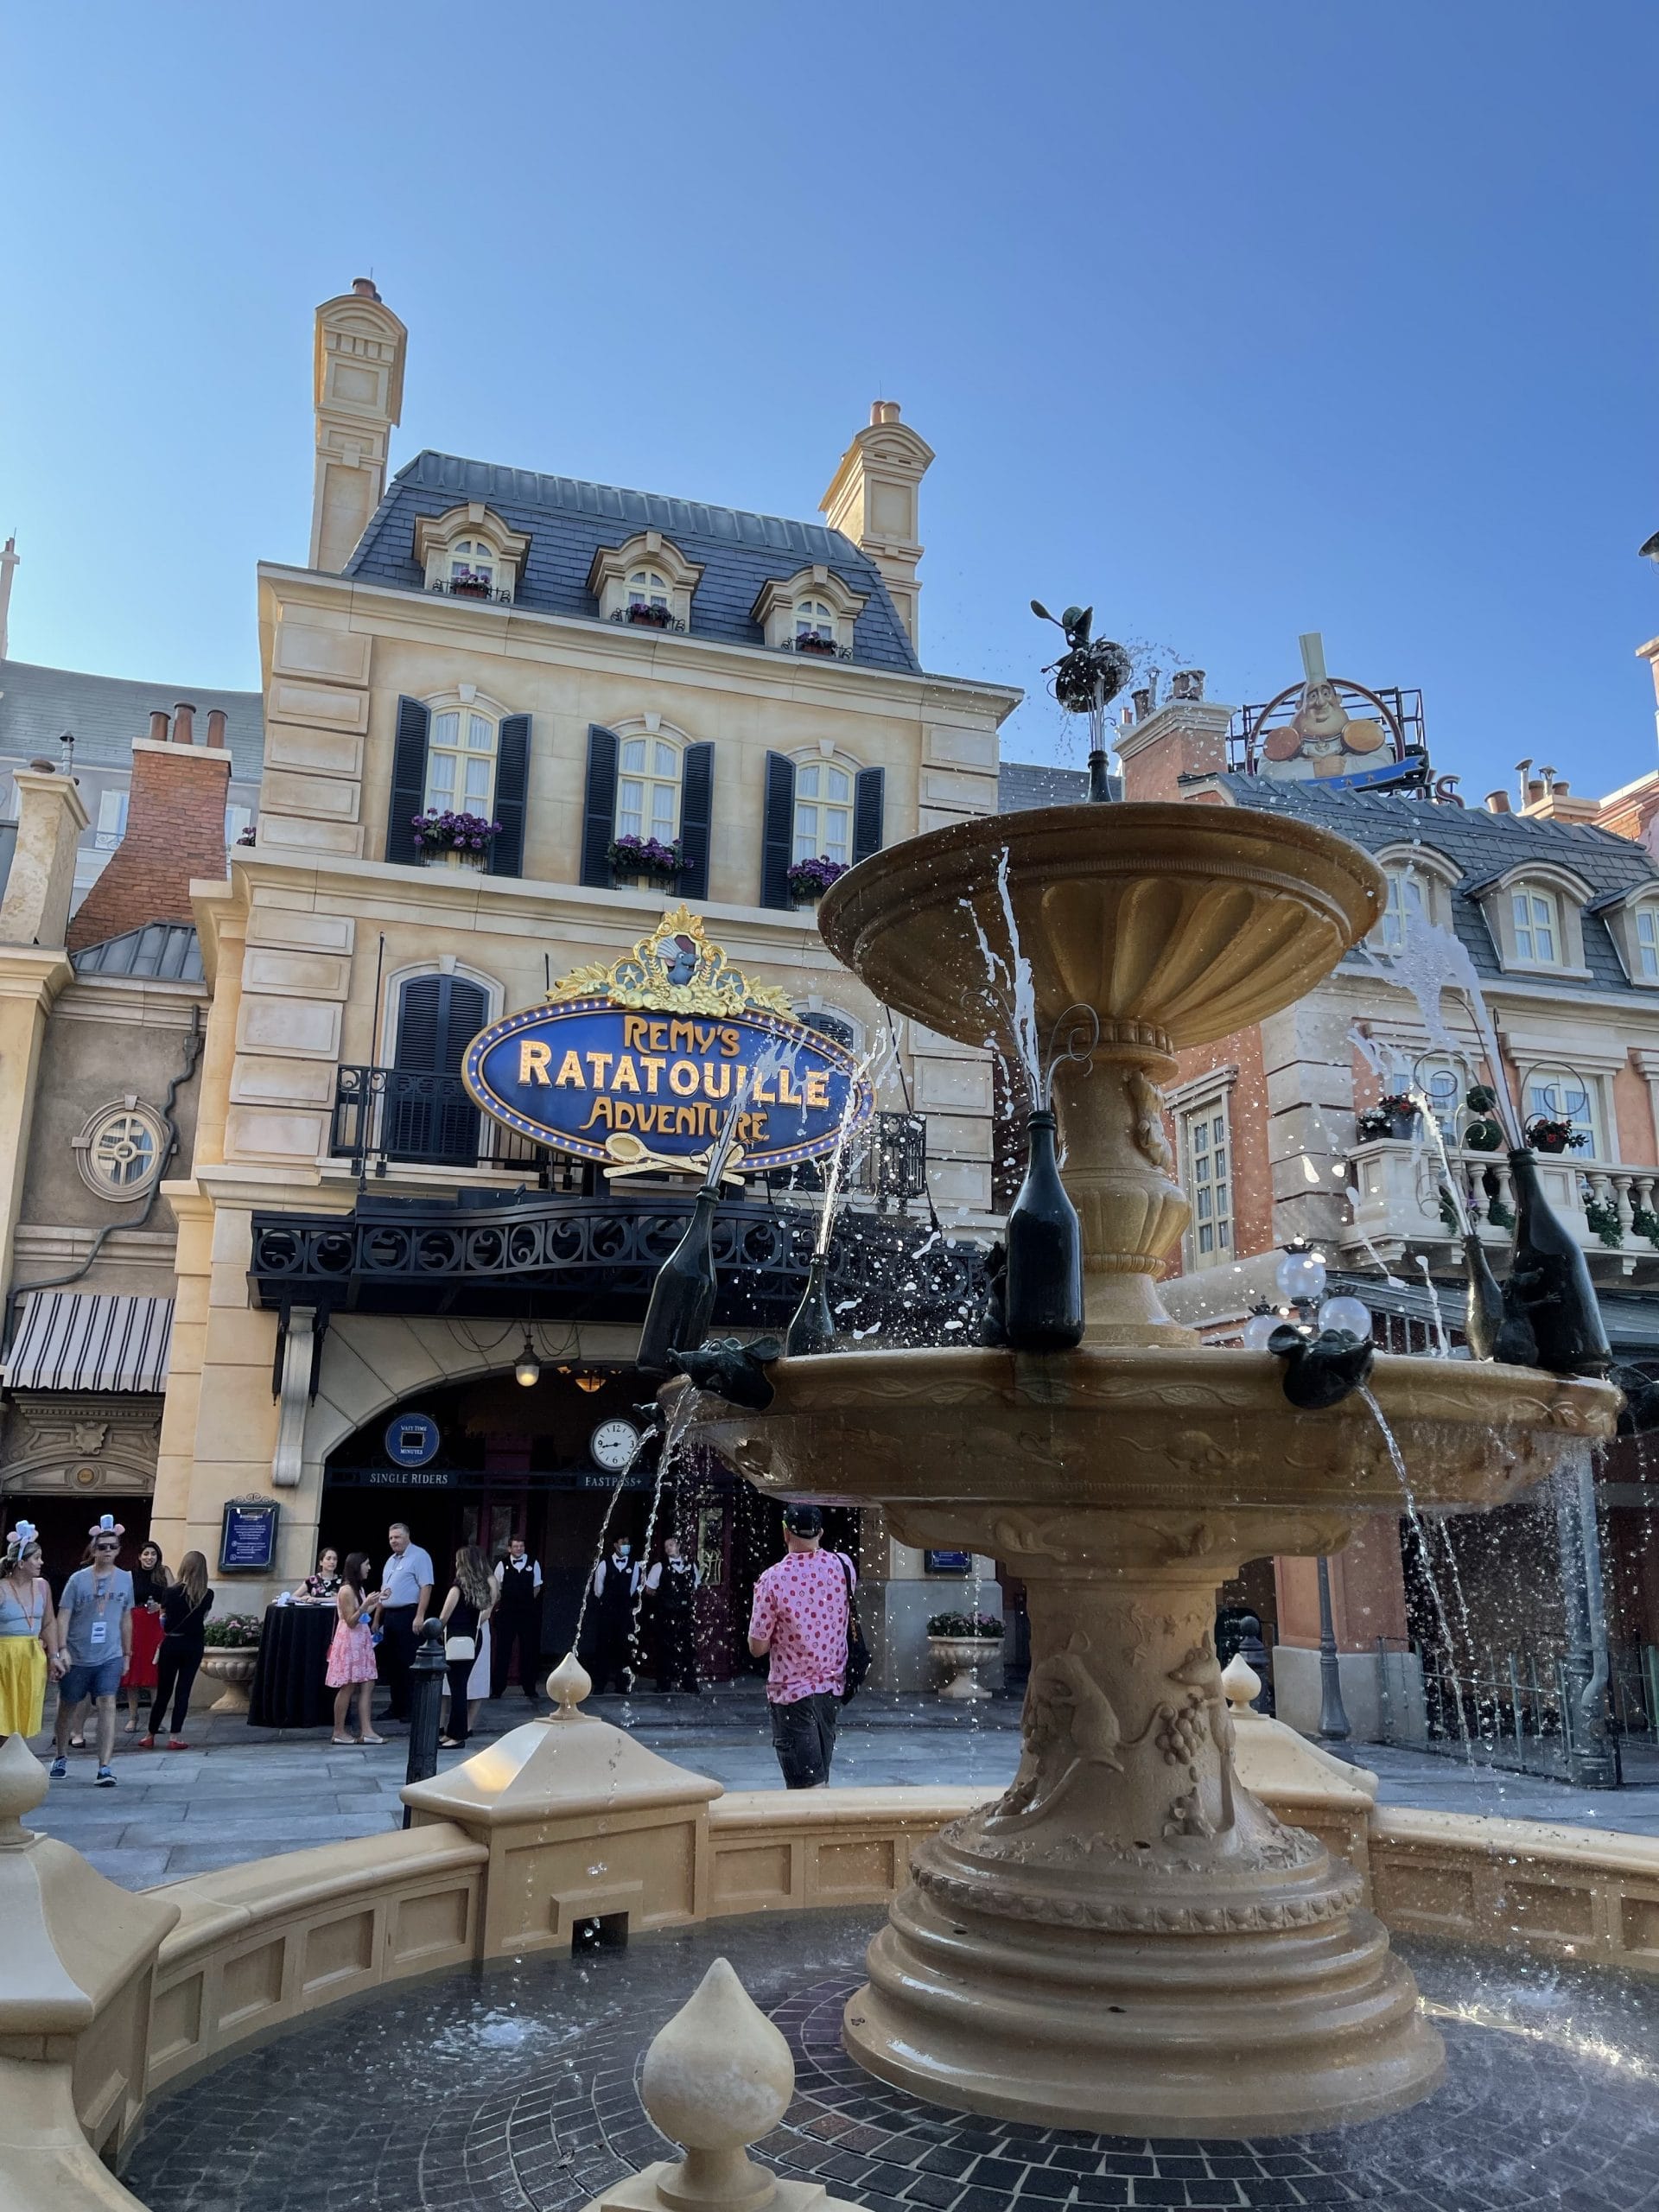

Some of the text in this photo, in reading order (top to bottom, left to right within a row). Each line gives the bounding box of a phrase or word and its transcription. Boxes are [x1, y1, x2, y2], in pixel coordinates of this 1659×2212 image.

[624, 1015, 741, 1057] REMY'S
[518, 1039, 830, 1109] RATATOUILLE
[579, 1096, 771, 1143] ADVENTURE
[613, 1456, 618, 1465] 6
[370, 1473, 448, 1484] SINGLE RIDERS
[585, 1477, 642, 1486] FASTPSS+
